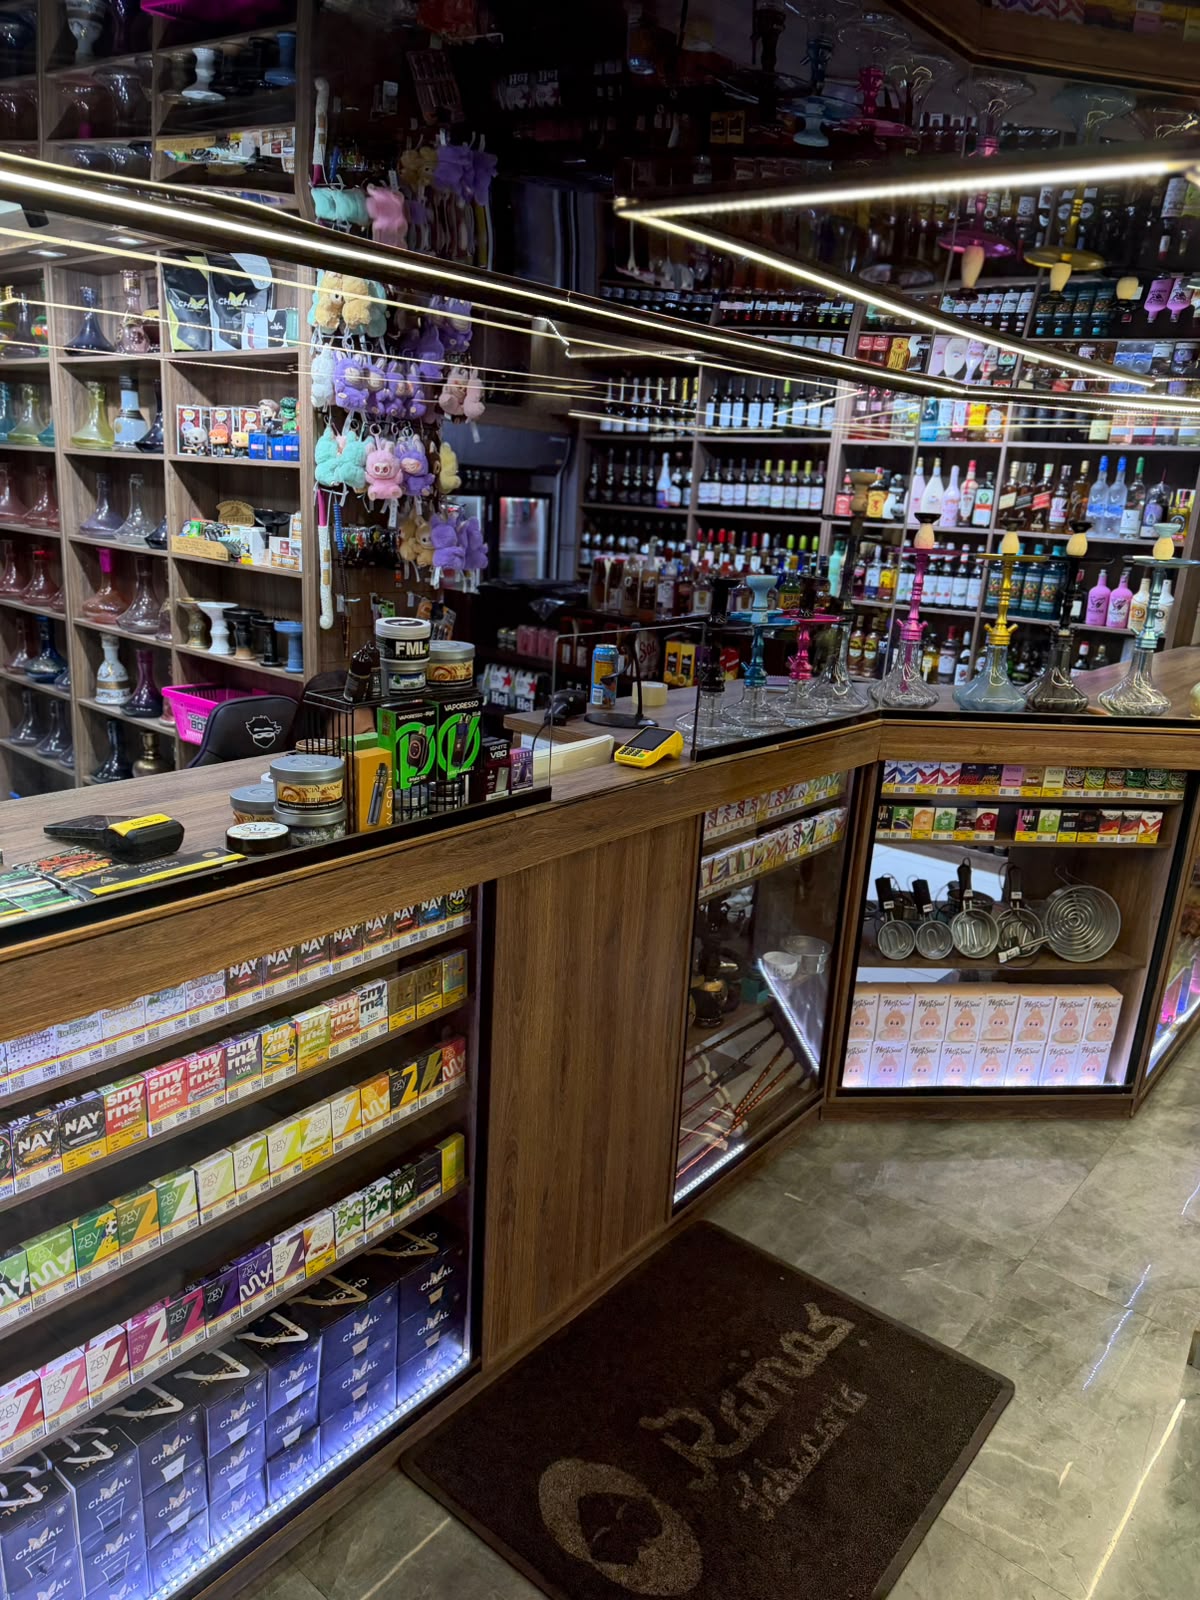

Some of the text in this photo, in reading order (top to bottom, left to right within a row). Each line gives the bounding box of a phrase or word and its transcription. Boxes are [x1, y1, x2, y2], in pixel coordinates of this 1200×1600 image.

[178, 298, 208, 310] CHACA
[218, 296, 255, 307] CHACAL
[395, 641, 426, 655] FML
[444, 700, 479, 711] VAPORESSO
[393, 906, 415, 921] NAY
[421, 896, 443, 911] NAY
[365, 915, 388, 931] NAY
[333, 925, 357, 943] NAY
[301, 935, 326, 954] NAY
[267, 946, 295, 965] NAY
[229, 958, 258, 978] NAY
[360, 983, 386, 1000] smy
[227, 1035, 259, 1054] smy
[189, 1051, 223, 1073] smy
[236, 1065, 251, 1075] UVA
[149, 1067, 186, 1090] smy
[393, 1076, 406, 1092] zgy
[56, 1097, 78, 1109] NAY
[106, 1083, 144, 1106] smy
[8, 1115, 31, 1126] NAY
[333, 1101, 349, 1120] zgy
[65, 1112, 99, 1136] NAY
[18, 1128, 54, 1155] NAY
[271, 1135, 288, 1153] zgy
[237, 1152, 254, 1171] zgy
[201, 1172, 220, 1190] zgy
[395, 1179, 414, 1199] NAY
[160, 1187, 180, 1207] zgy
[120, 1206, 141, 1227] zgy
[77, 1229, 100, 1250] zgy
[275, 1248, 292, 1264] zgy
[242, 1261, 259, 1278] zgy
[420, 1265, 453, 1291] CHACAL
[207, 1285, 225, 1302] zgy
[169, 1307, 189, 1325] zgy
[417, 1310, 449, 1336] CHACAL
[343, 1314, 379, 1342] CHACAL
[90, 1349, 110, 1370] zgy
[279, 1362, 314, 1388] CHACAL
[341, 1360, 378, 1388] CHACAL
[47, 1376, 69, 1396] zgy
[219, 1400, 257, 1429] CHACAL
[276, 1406, 310, 1434] CHACAL
[151, 1435, 192, 1465] CHACAL
[219, 1446, 256, 1475] CHACAL
[279, 1454, 313, 1480] CHACAL
[88, 1478, 131, 1509] CHACAL
[158, 1487, 198, 1518] CHACAL
[221, 1491, 257, 1521] CHACAL
[15, 1526, 64, 1560] CHACAL
[93, 1533, 136, 1564] CHACAL
